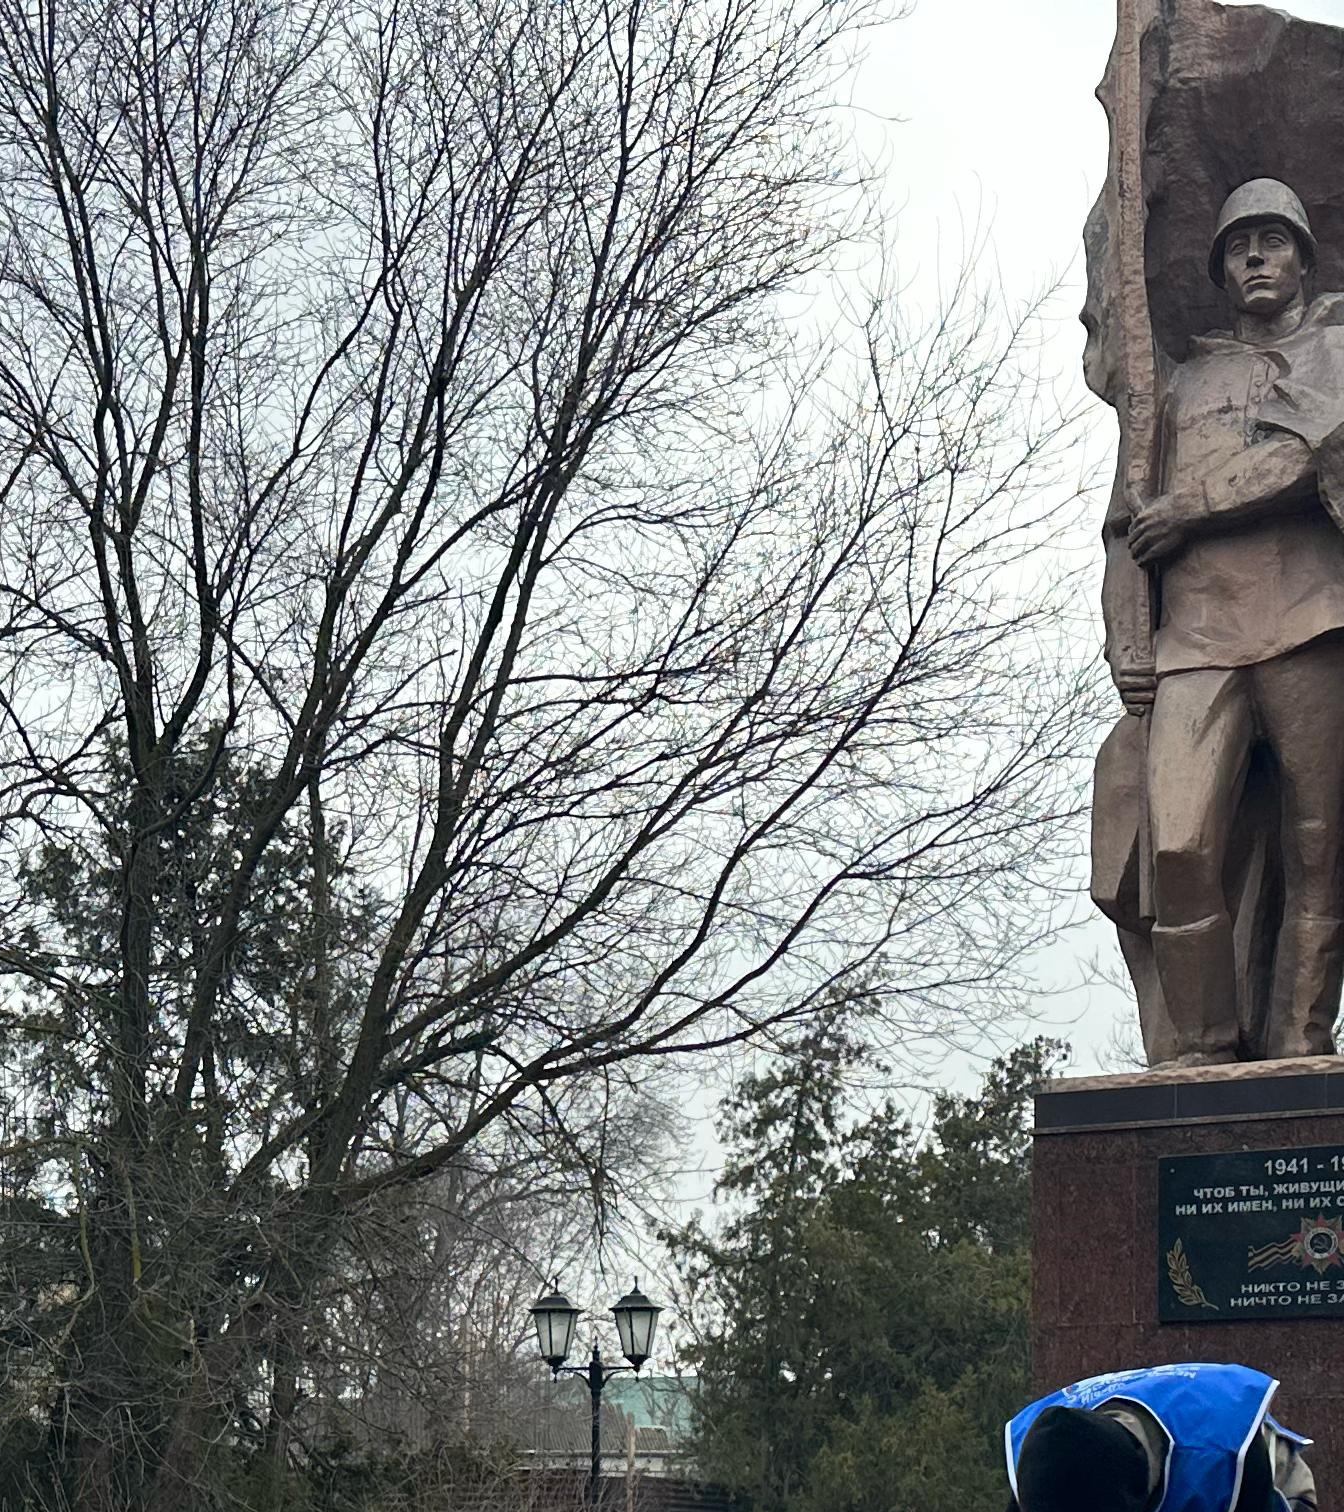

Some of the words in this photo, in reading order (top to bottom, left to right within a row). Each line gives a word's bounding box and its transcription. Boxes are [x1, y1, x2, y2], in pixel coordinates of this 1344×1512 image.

[1264, 1157, 1308, 1176] 1941
[1194, 1185, 1235, 1199] ЧТОБ
[1239, 1184, 1269, 1198] ТЫ,
[1176, 1204, 1197, 1215] НИ
[1202, 1202, 1223, 1214] ИХ
[1228, 1200, 1277, 1213] ИМЕН,
[1282, 1198, 1304, 1210] НИ
[1310, 1196, 1331, 1208] ИХ
[1241, 1281, 1300, 1293] НИКТО
[1307, 1280, 1329, 1291] НЕ
[1231, 1294, 1292, 1307] НИЧТО
[1297, 1293, 1322, 1305] НЕ
